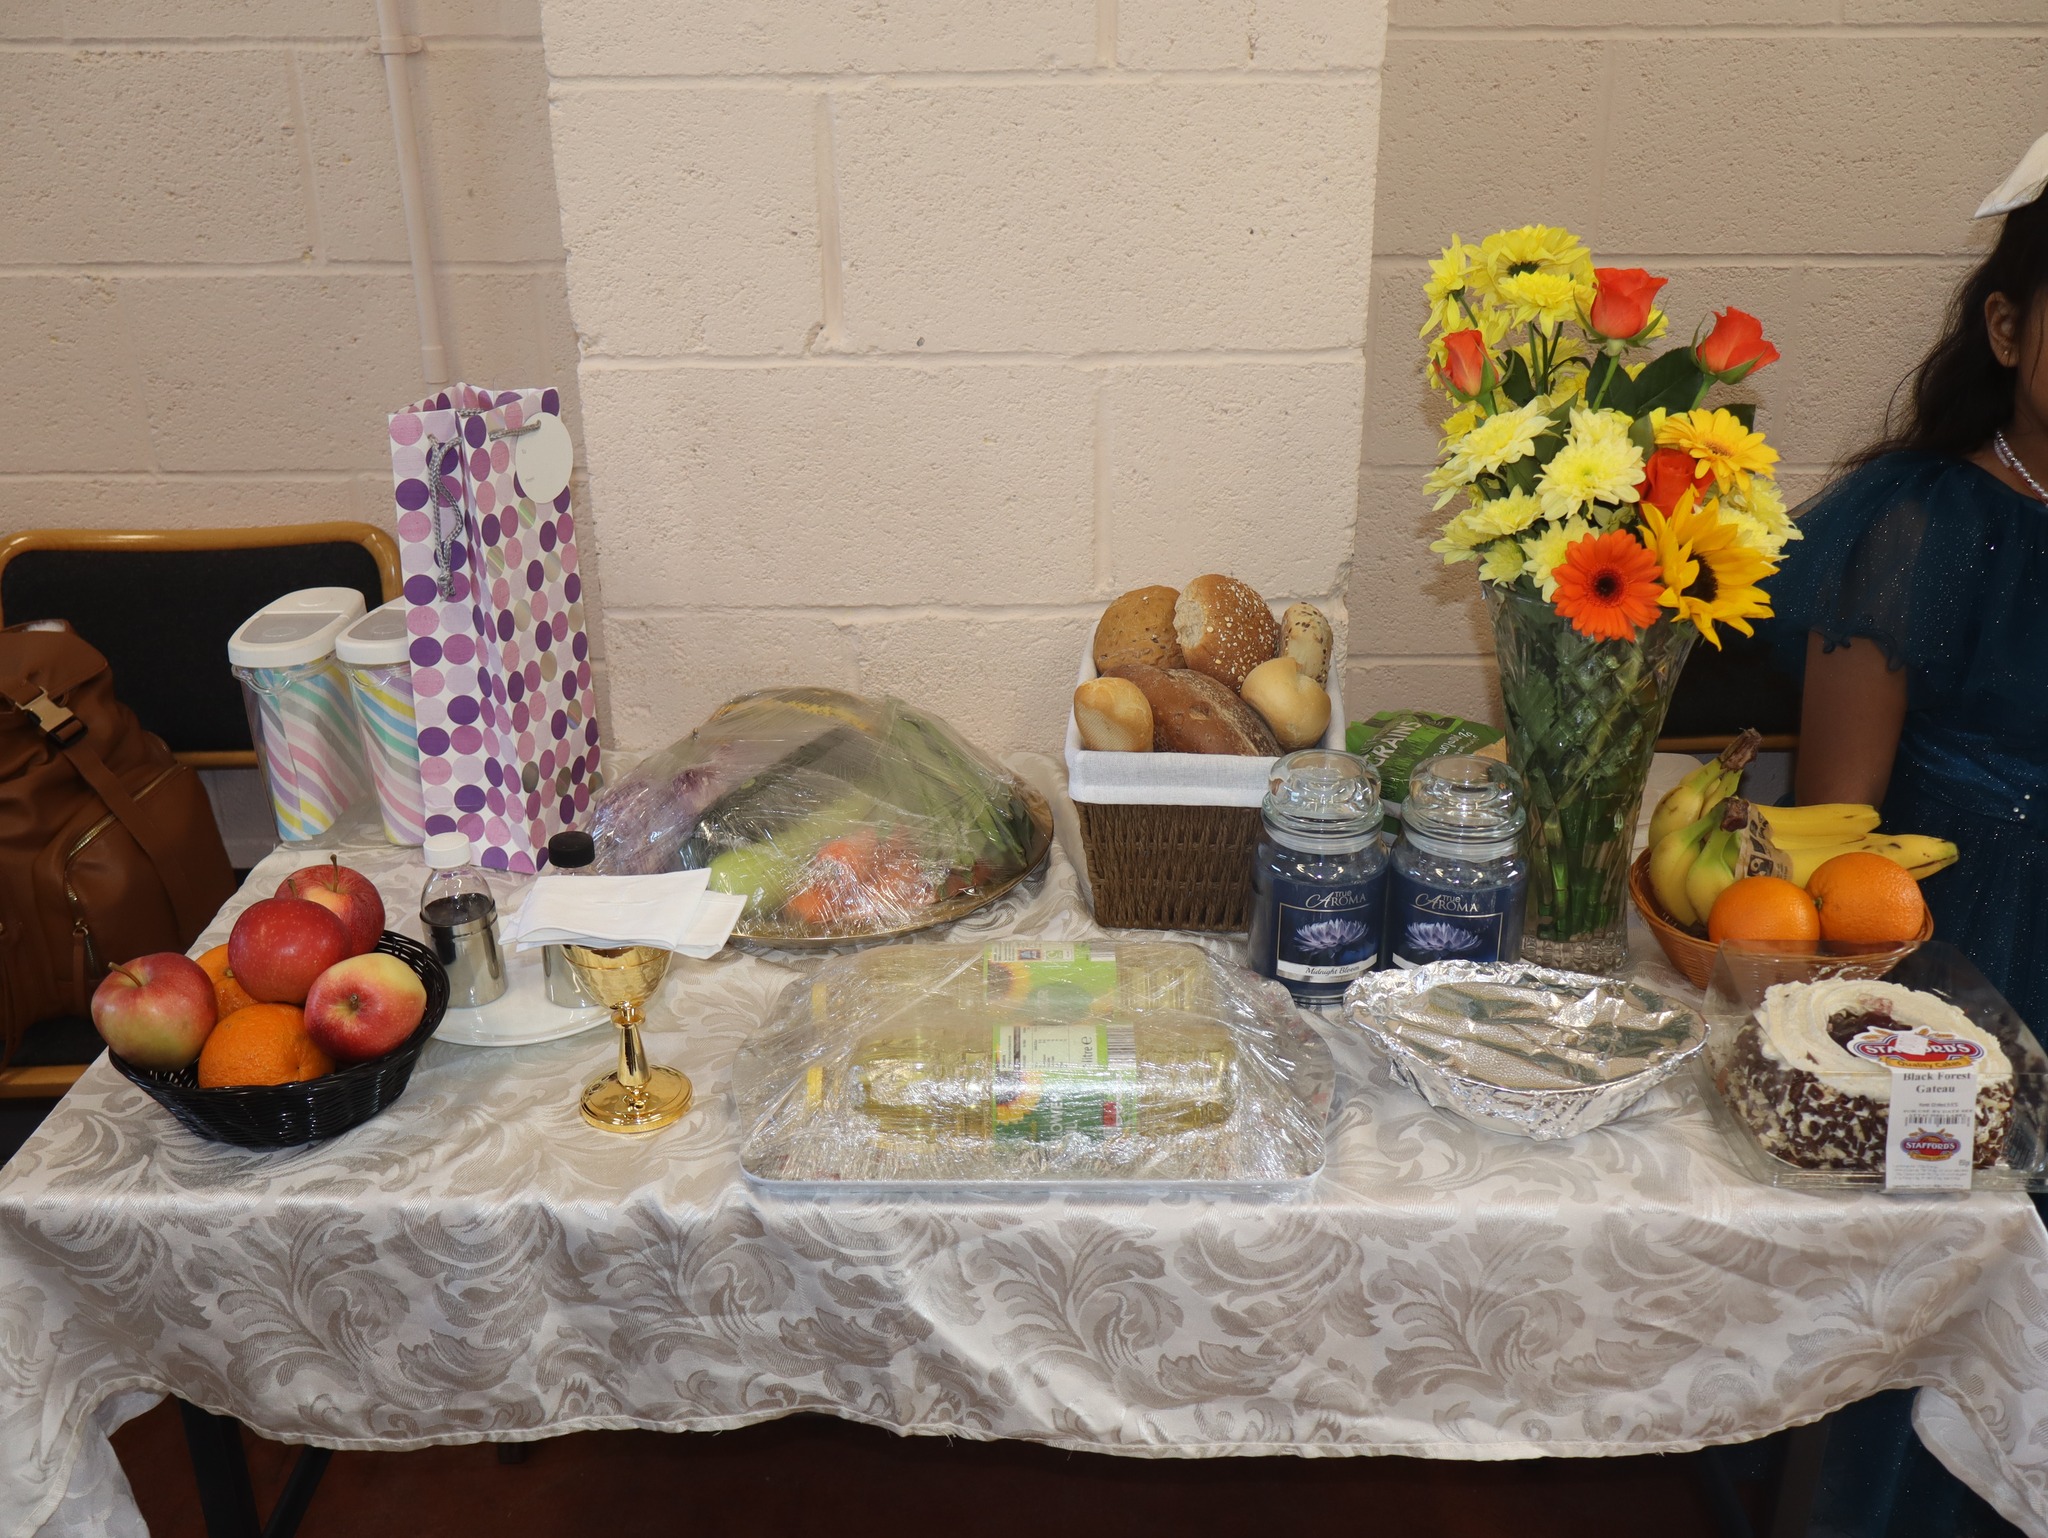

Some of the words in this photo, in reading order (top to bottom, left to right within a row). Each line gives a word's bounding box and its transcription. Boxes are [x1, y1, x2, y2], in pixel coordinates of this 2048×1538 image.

[1305, 892, 1367, 908] AROMA
[1415, 893, 1478, 912] AROMA
[1305, 966, 1338, 977] Midnight
[1897, 1060, 1933, 1069] Quality
[1935, 1060, 1962, 1068] Cakes
[1903, 1072, 1933, 1081] Black
[1938, 1072, 1971, 1080] Forest
[1916, 1084, 1956, 1094] Gateau
